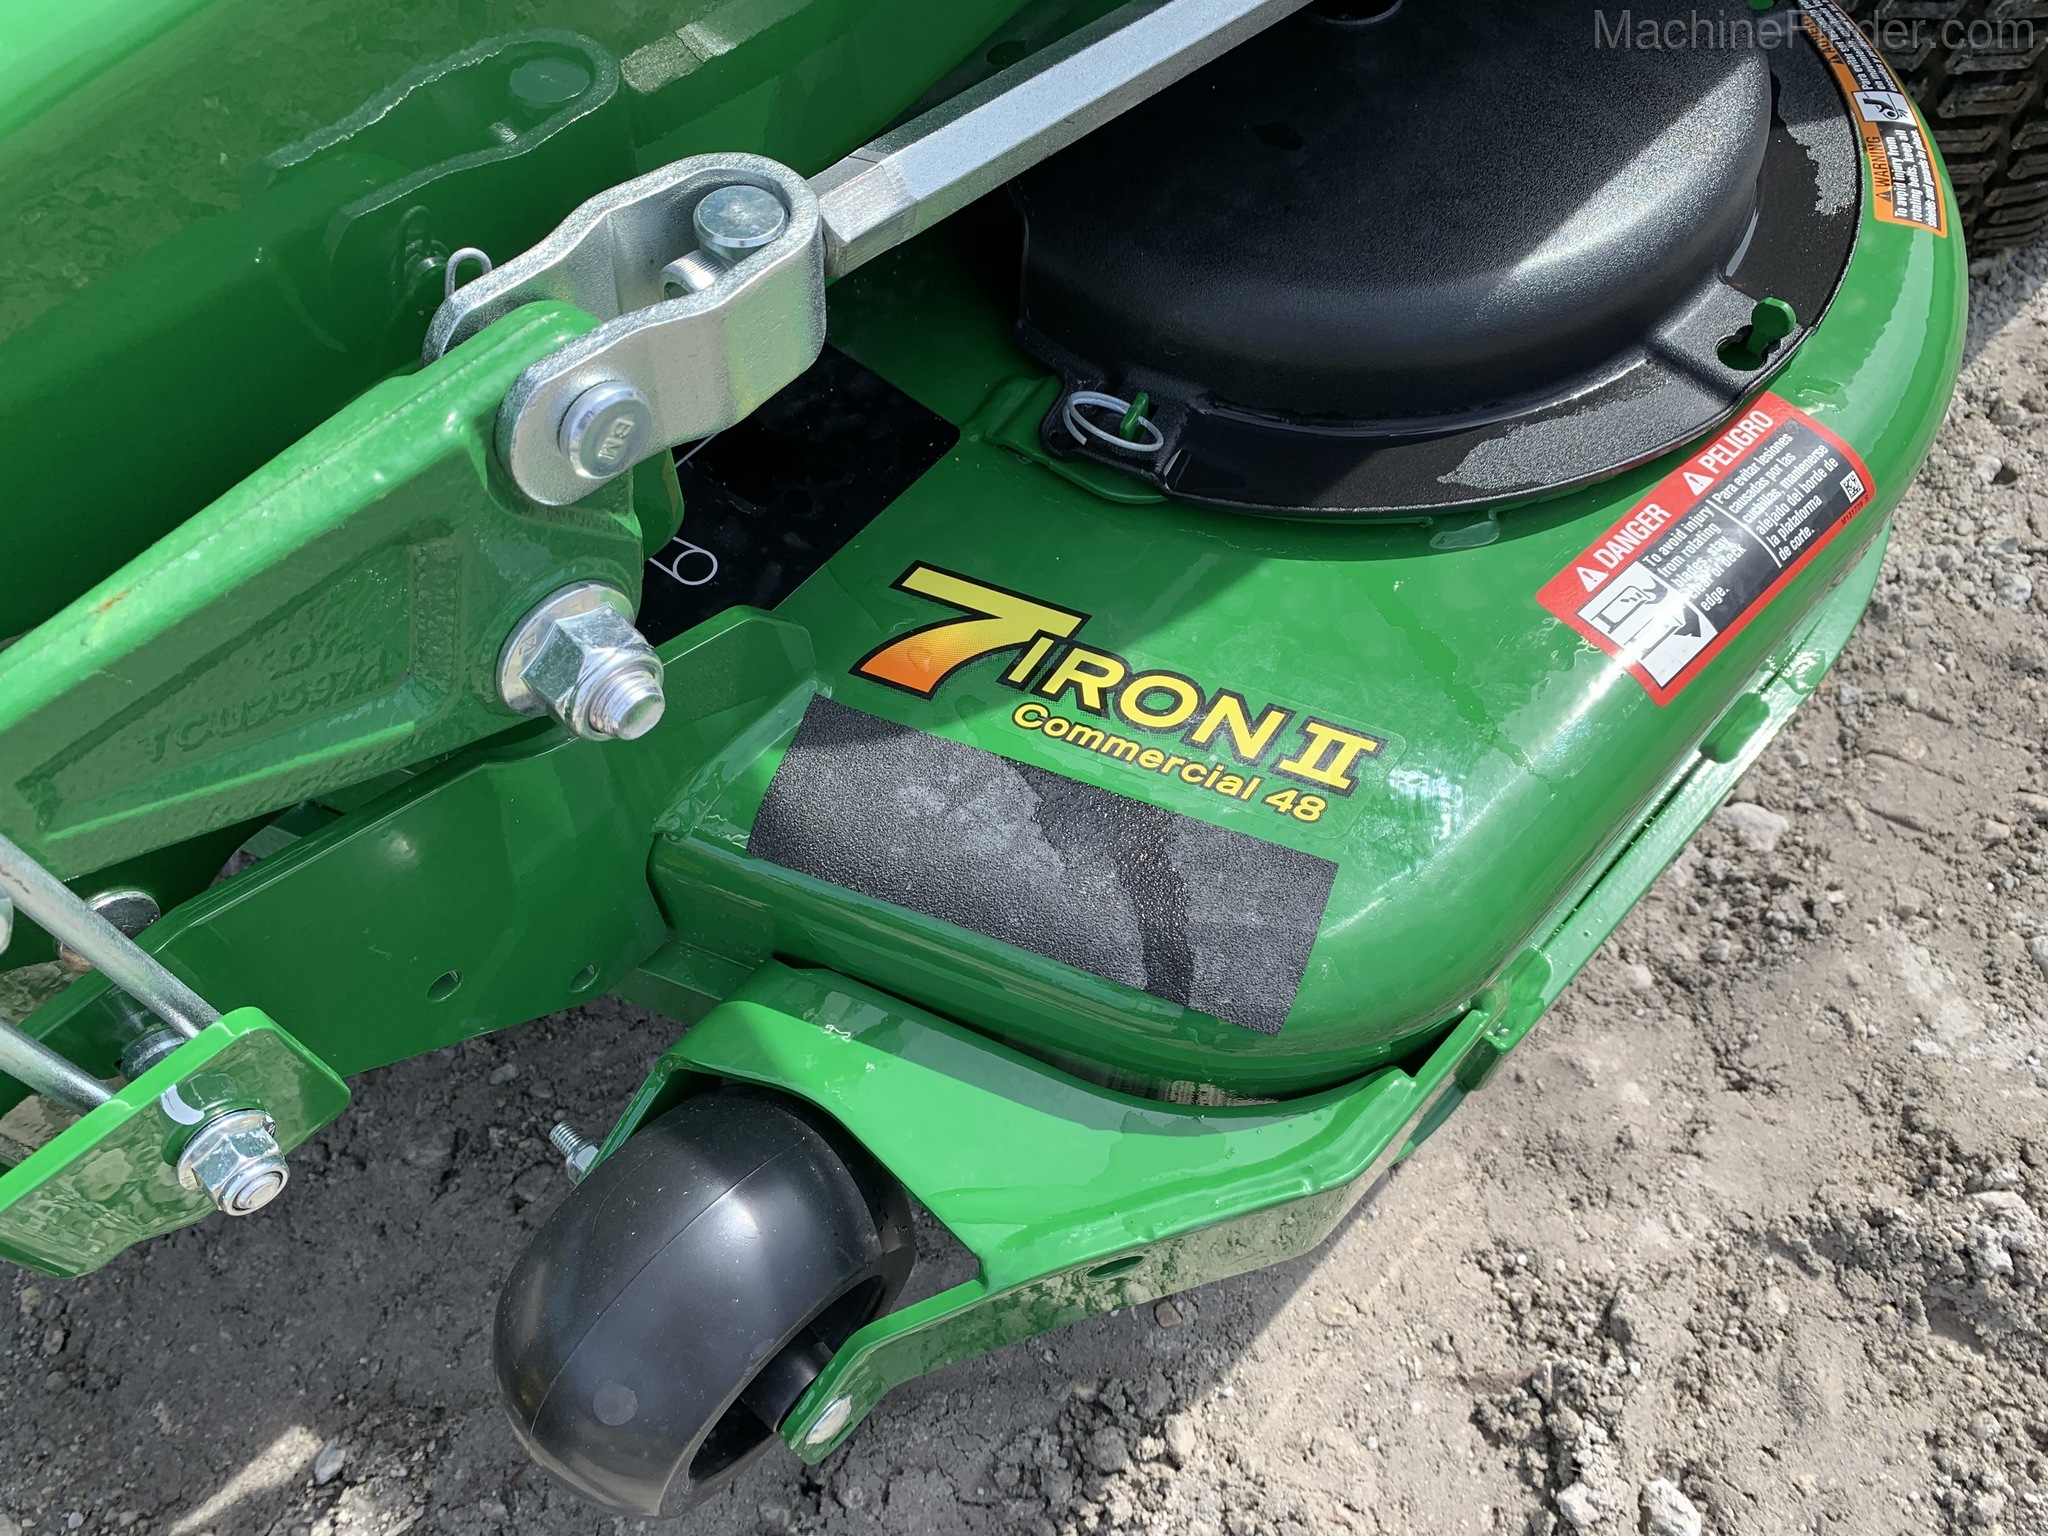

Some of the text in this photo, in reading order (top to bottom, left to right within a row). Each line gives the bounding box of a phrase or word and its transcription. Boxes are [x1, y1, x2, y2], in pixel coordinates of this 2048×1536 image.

[1835, 41, 1850, 52] ser
[1843, 53, 1863, 73] evitar
[1858, 73, 1874, 90] Para
[1874, 80, 1886, 90] en
[1866, 136, 1891, 187] WARNING
[1885, 136, 1909, 218] To avoid injury from
[1894, 129, 1923, 221] rotating belts, keep all
[1918, 159, 1935, 186] guards
[1922, 184, 1936, 200] and
[1924, 200, 1938, 228] shields
[597, 416, 636, 460] BM
[1698, 410, 1774, 474] PELIGRO
[1712, 433, 1794, 505] Para evitar lesiones
[1728, 452, 1797, 514] causadas por las
[1742, 444, 1829, 524] cuchillas, mantenerse
[1755, 457, 1839, 536] alejado del borde de
[1766, 495, 1823, 549] la plataforma
[1593, 503, 1673, 570] DANGER
[1642, 505, 1716, 568] To avoid injury
[1657, 522, 1722, 578] from rotating
[1671, 535, 1732, 589] blades, stay
[1712, 560, 1725, 576] of
[1720, 543, 1748, 568] deck
[1778, 525, 1816, 563] de corte.
[1699, 586, 1731, 612] edge.
[849, 560, 1384, 795] 7 IRON II
[1012, 702, 1329, 824] Commercial 48
